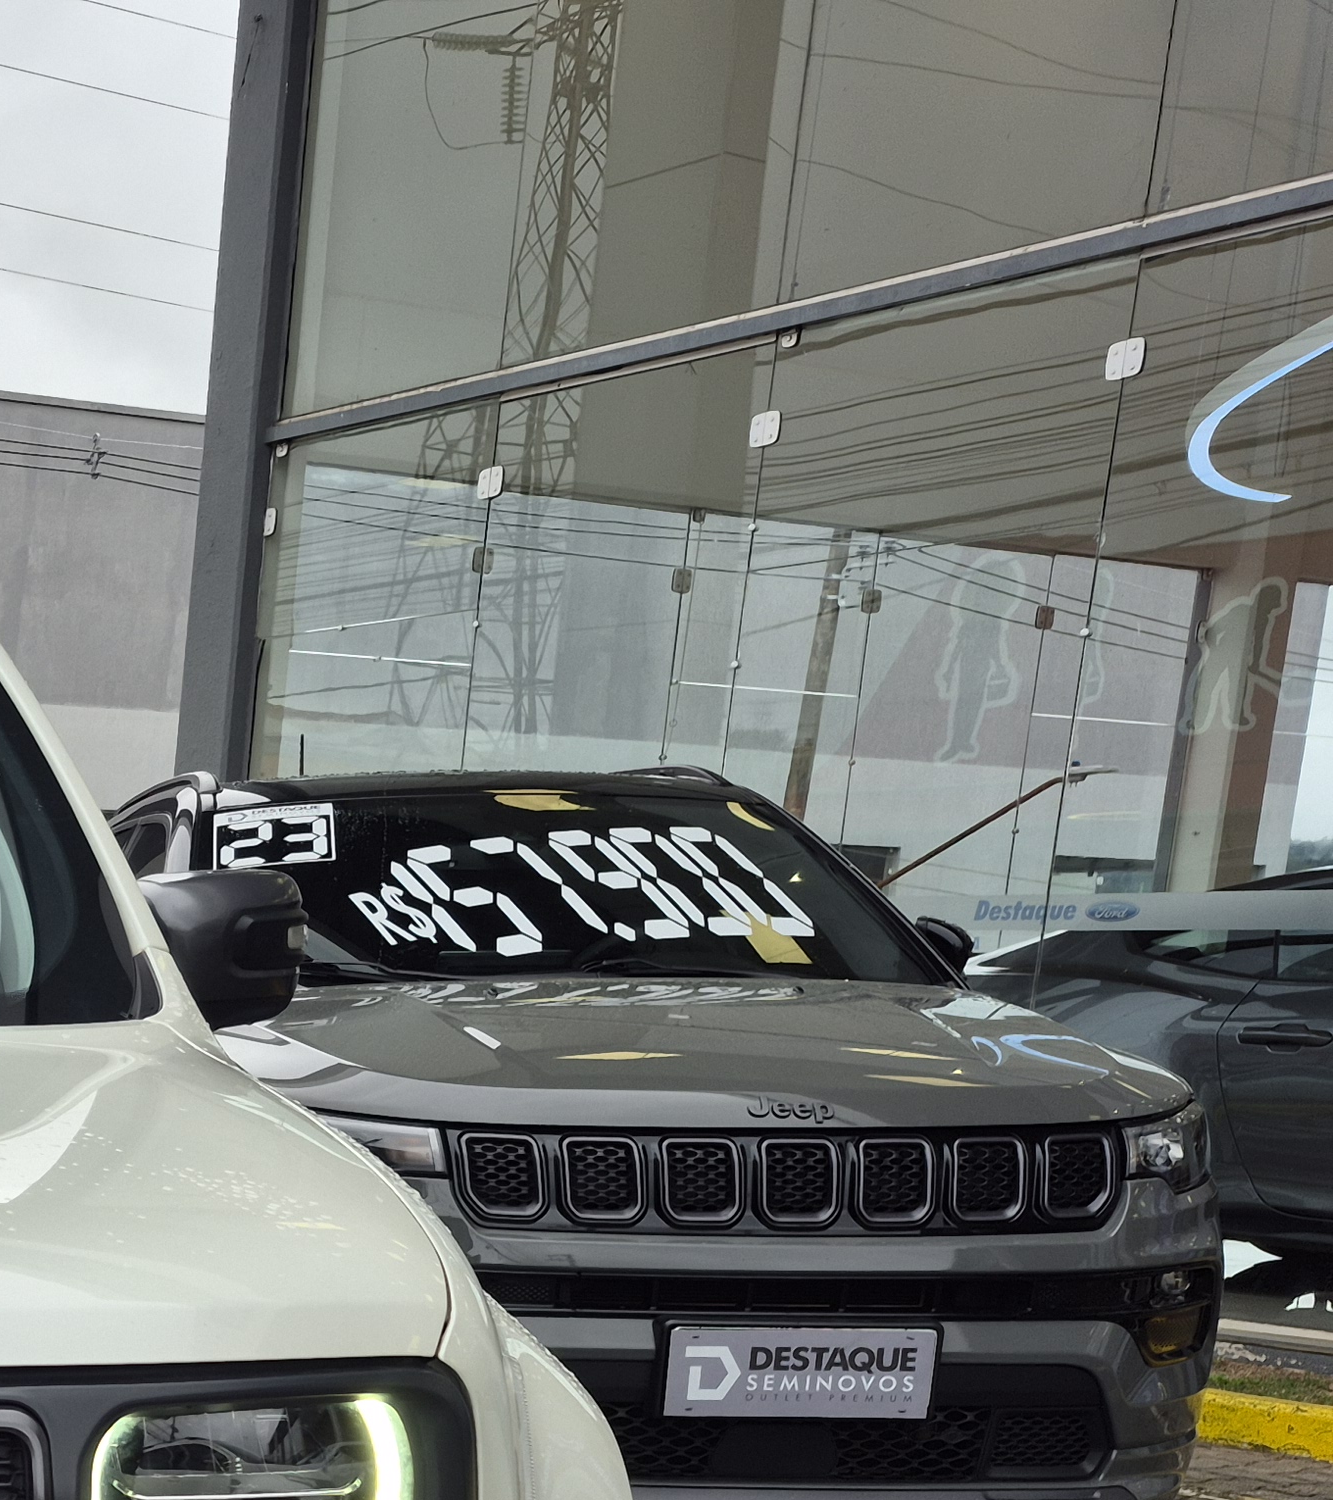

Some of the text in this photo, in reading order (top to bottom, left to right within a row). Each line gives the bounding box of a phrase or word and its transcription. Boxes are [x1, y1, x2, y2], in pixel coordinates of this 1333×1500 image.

[220, 816, 328, 867] 23
[974, 900, 1130, 924] Destaque Ford
[747, 1096, 834, 1124] Jeep
[749, 1346, 918, 1374] DESTAQUE
[746, 1374, 914, 1392] SEMINOVOS
[745, 1393, 913, 1403] OUTLET PREMIUM
